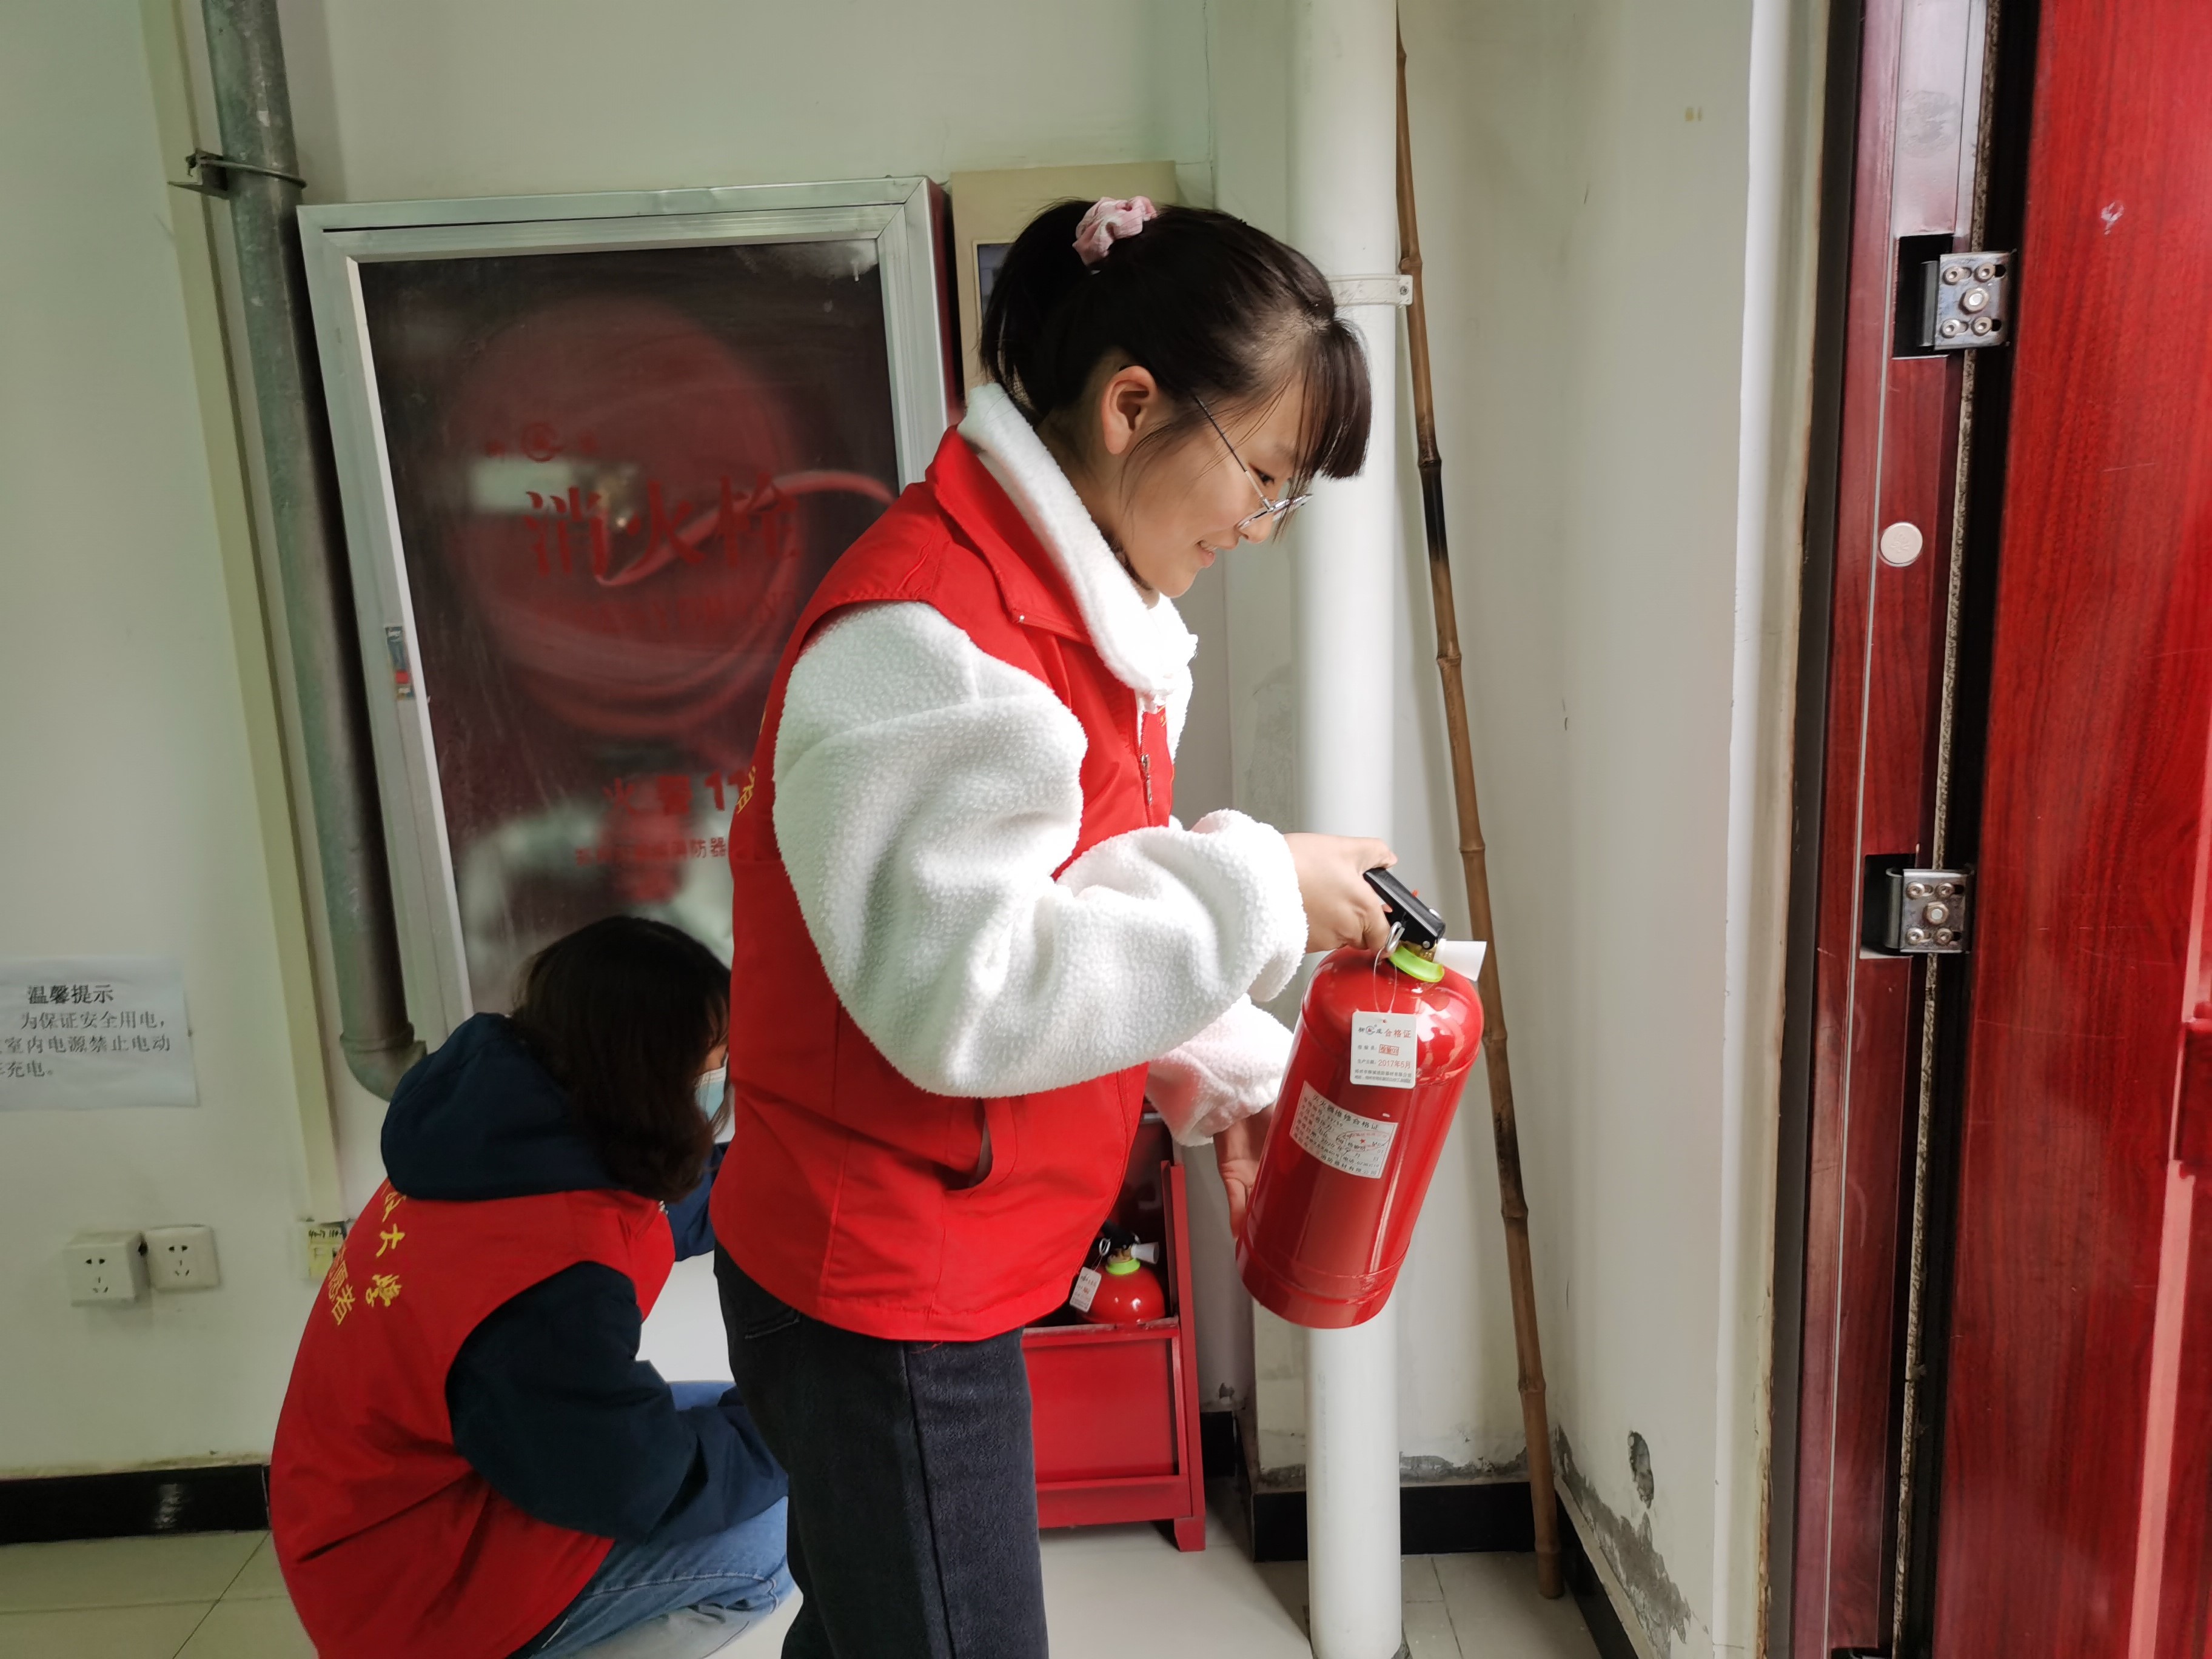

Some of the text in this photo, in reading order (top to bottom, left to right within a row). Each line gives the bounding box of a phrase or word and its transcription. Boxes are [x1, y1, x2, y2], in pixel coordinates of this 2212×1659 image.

[27, 984, 115, 1005] 温馨提示
[0, 1033, 170, 1054] 室内电源禁止电动
[1384, 1028, 1412, 1038] 合格证
